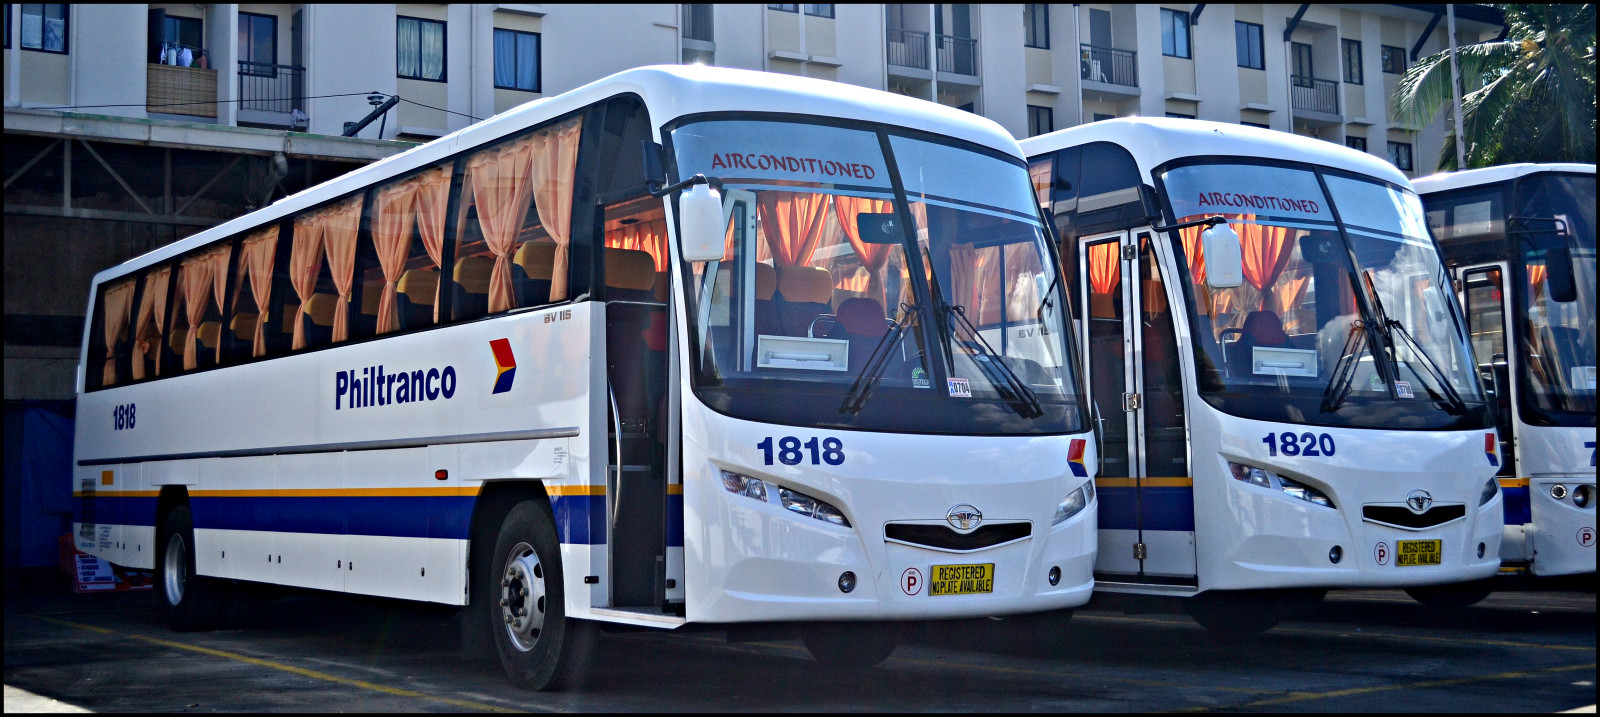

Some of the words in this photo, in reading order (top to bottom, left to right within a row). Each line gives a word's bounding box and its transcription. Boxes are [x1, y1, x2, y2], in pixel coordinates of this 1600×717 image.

[711, 153, 876, 180] AIRCONDITIONED
[1198, 192, 1319, 214] AIRCONDITIONED
[544, 311, 557, 324] BV
[335, 364, 457, 410] Philtranco
[113, 402, 136, 431] 1818
[757, 436, 846, 466] 1818
[1262, 431, 1336, 457] 1820
[1582, 532, 1592, 544] P
[1378, 549, 1386, 562] P
[1402, 541, 1436, 554] REGISTERED
[1404, 553, 1416, 565] PLATE
[1417, 552, 1440, 564] AVAILABLE
[939, 565, 986, 581] REGISTERED
[907, 576, 917, 592] P
[932, 581, 940, 594] NO
[940, 580, 958, 593] PLATE
[959, 579, 991, 593] AVAILABLE
